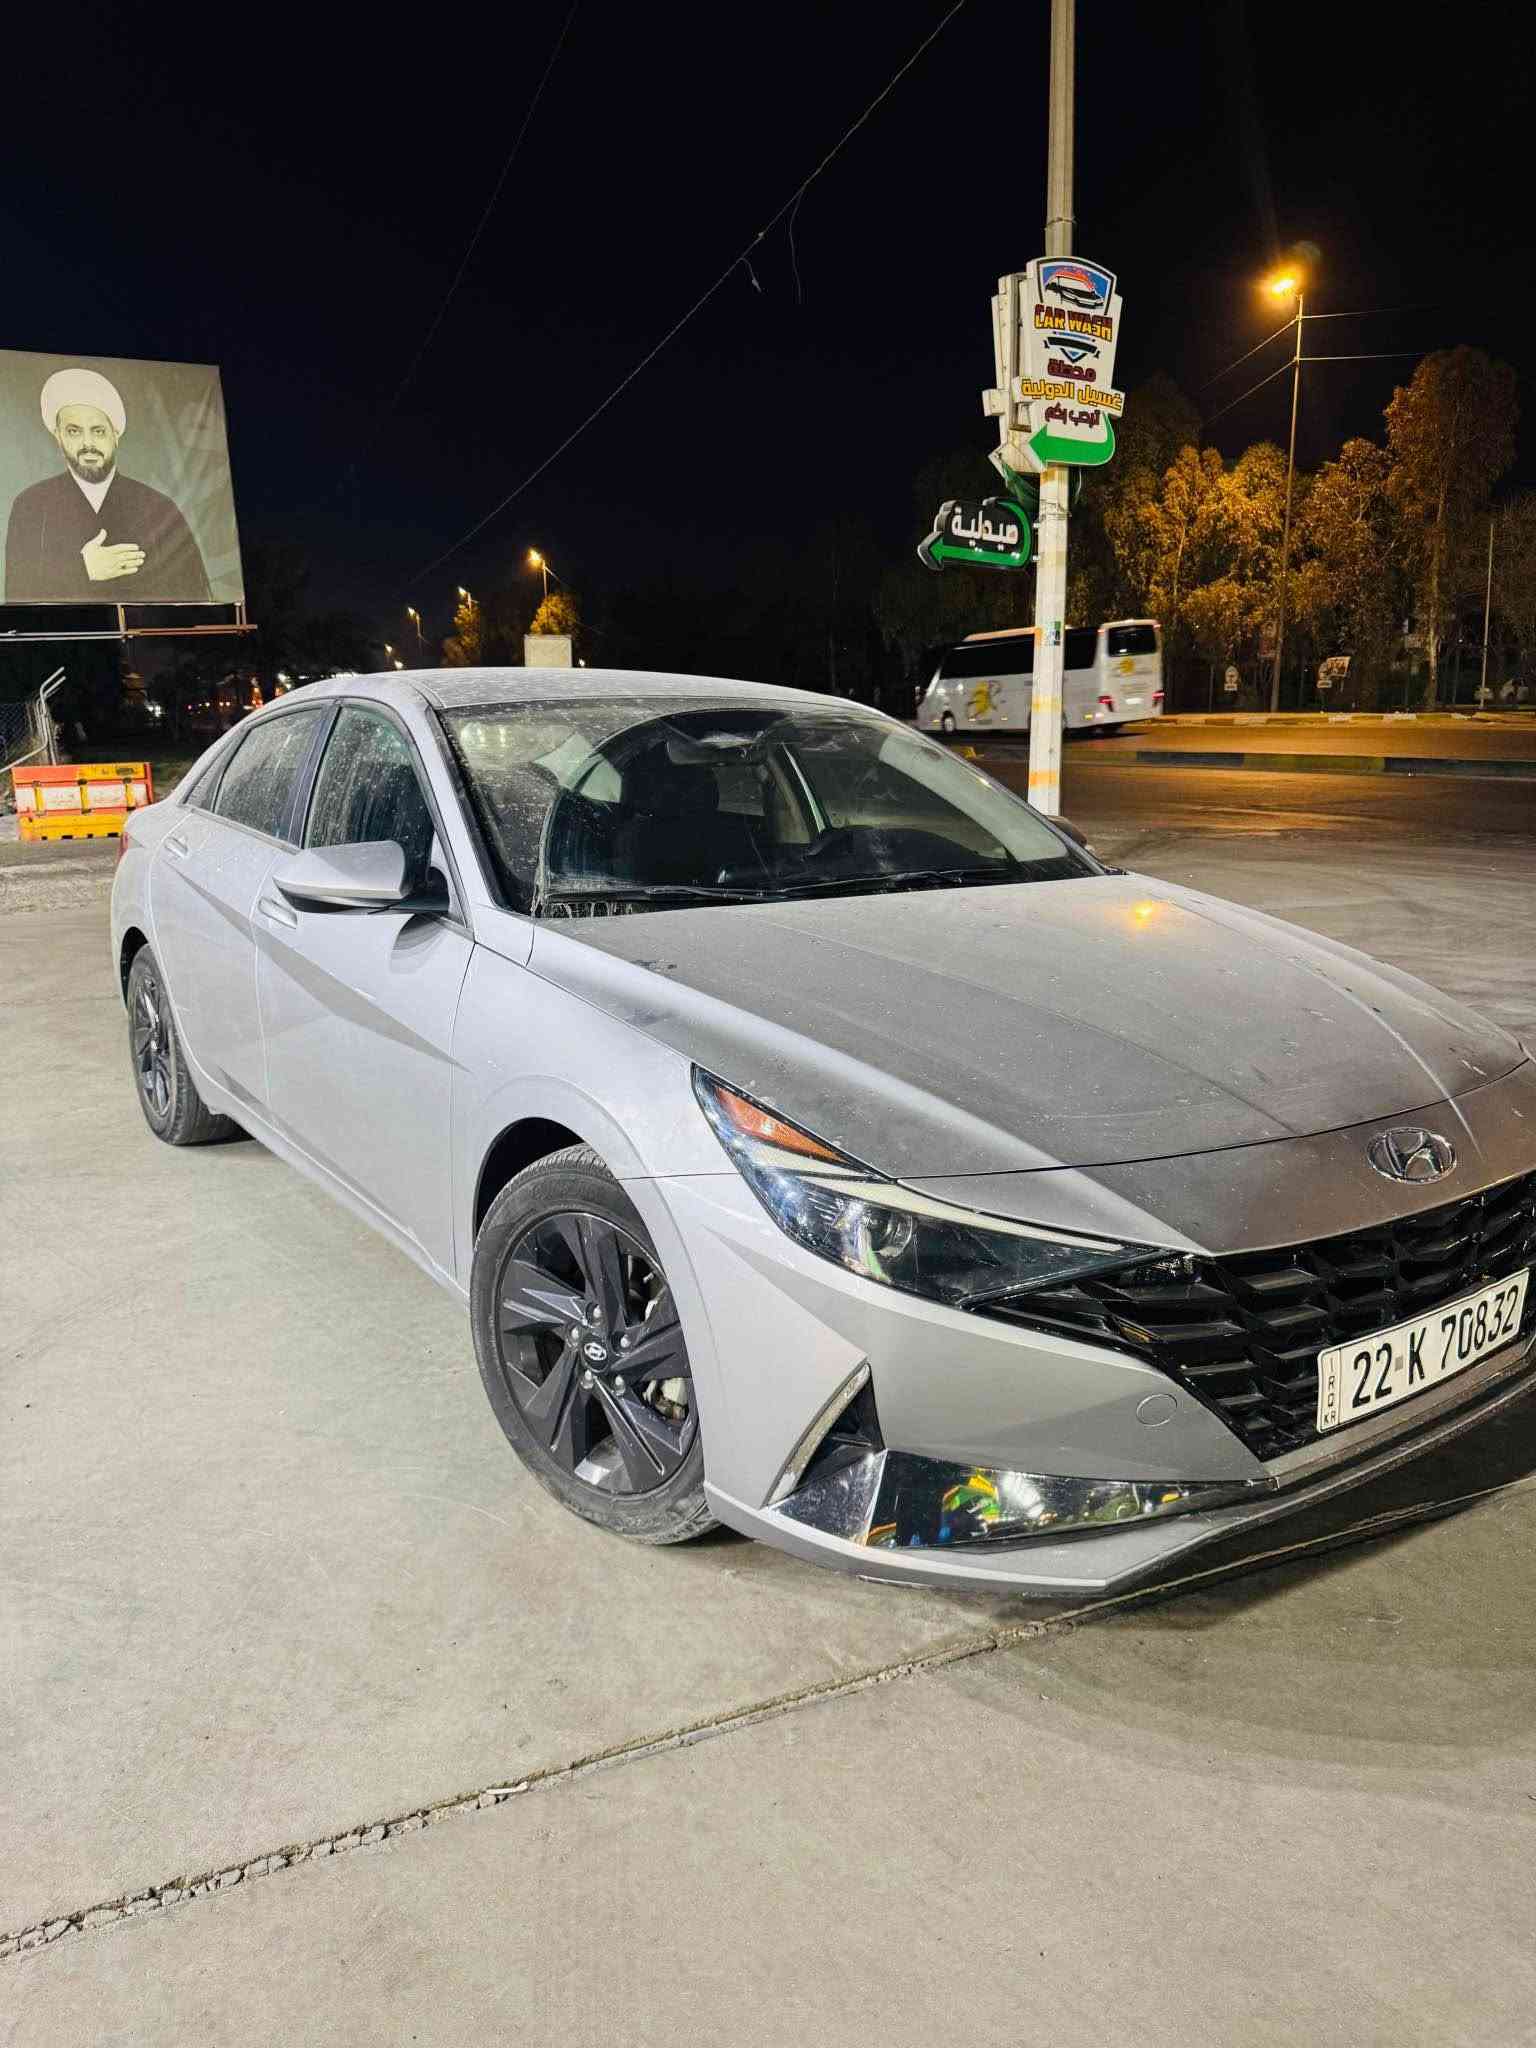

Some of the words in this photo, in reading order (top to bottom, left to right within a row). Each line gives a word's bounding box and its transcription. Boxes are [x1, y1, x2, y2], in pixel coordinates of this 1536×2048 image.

[1034, 303, 1066, 330] CAR
[1021, 378, 1076, 400] الدولية
[1077, 384, 1122, 411] غسيل
[951, 506, 1019, 552] صيدلية
[1352, 1342, 1393, 1409] 22
[1408, 1327, 1427, 1385] K
[1440, 1284, 1520, 1370] 70832
